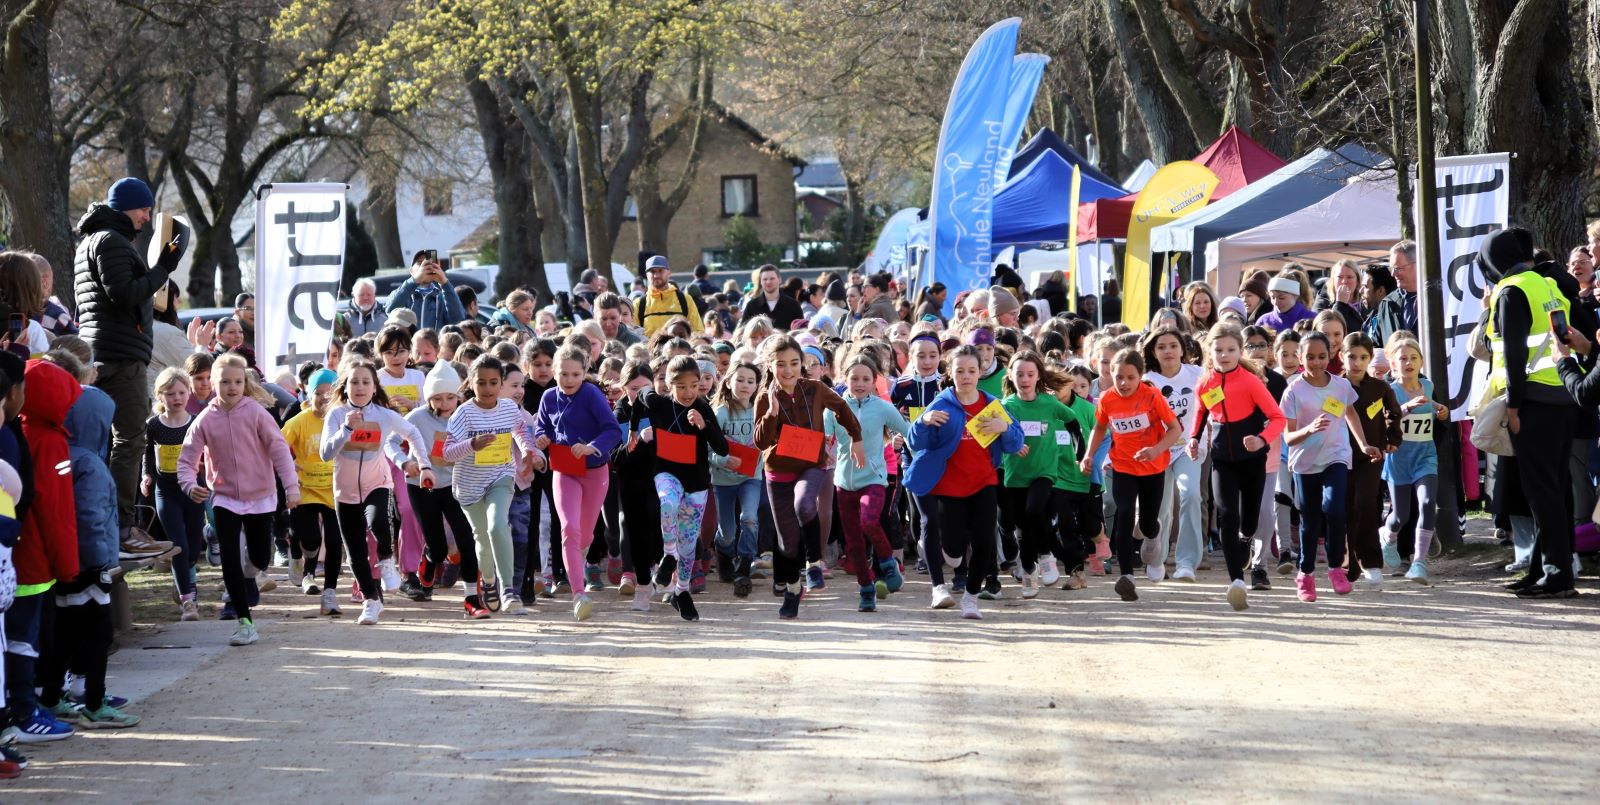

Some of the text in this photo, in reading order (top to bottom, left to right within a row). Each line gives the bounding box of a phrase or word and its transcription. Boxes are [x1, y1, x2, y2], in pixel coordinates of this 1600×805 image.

[970, 120, 1003, 290] Schule Neuland
[274, 199, 341, 376] tart
[723, 421, 755, 436] GLO
[1115, 419, 1142, 431] 1518
[1402, 418, 1432, 434] 172
